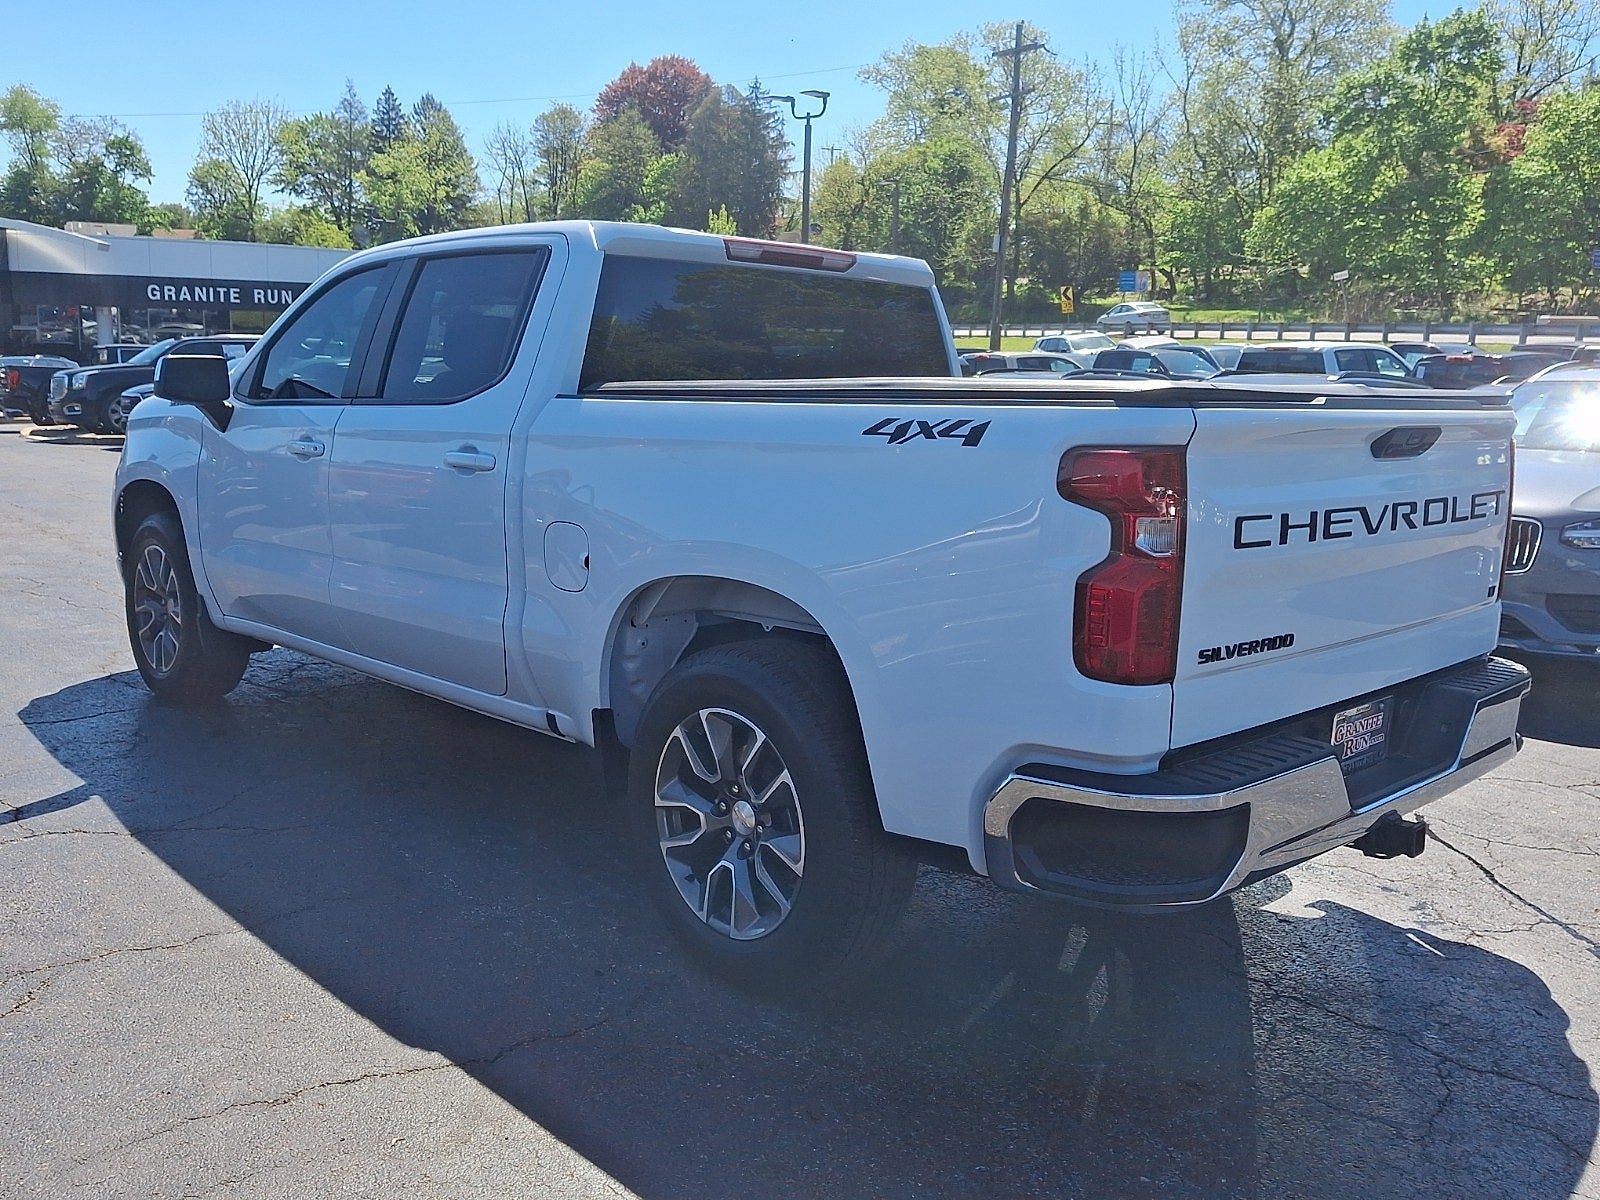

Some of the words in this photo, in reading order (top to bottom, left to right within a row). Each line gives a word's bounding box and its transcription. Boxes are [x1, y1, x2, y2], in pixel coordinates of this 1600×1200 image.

[147, 284, 240, 303] GRANITE
[254, 289, 293, 304] RUN
[1234, 490, 1505, 549] CHEVROLET
[1197, 633, 1295, 665] SILVERADO
[1335, 712, 1384, 745] GRANITE
